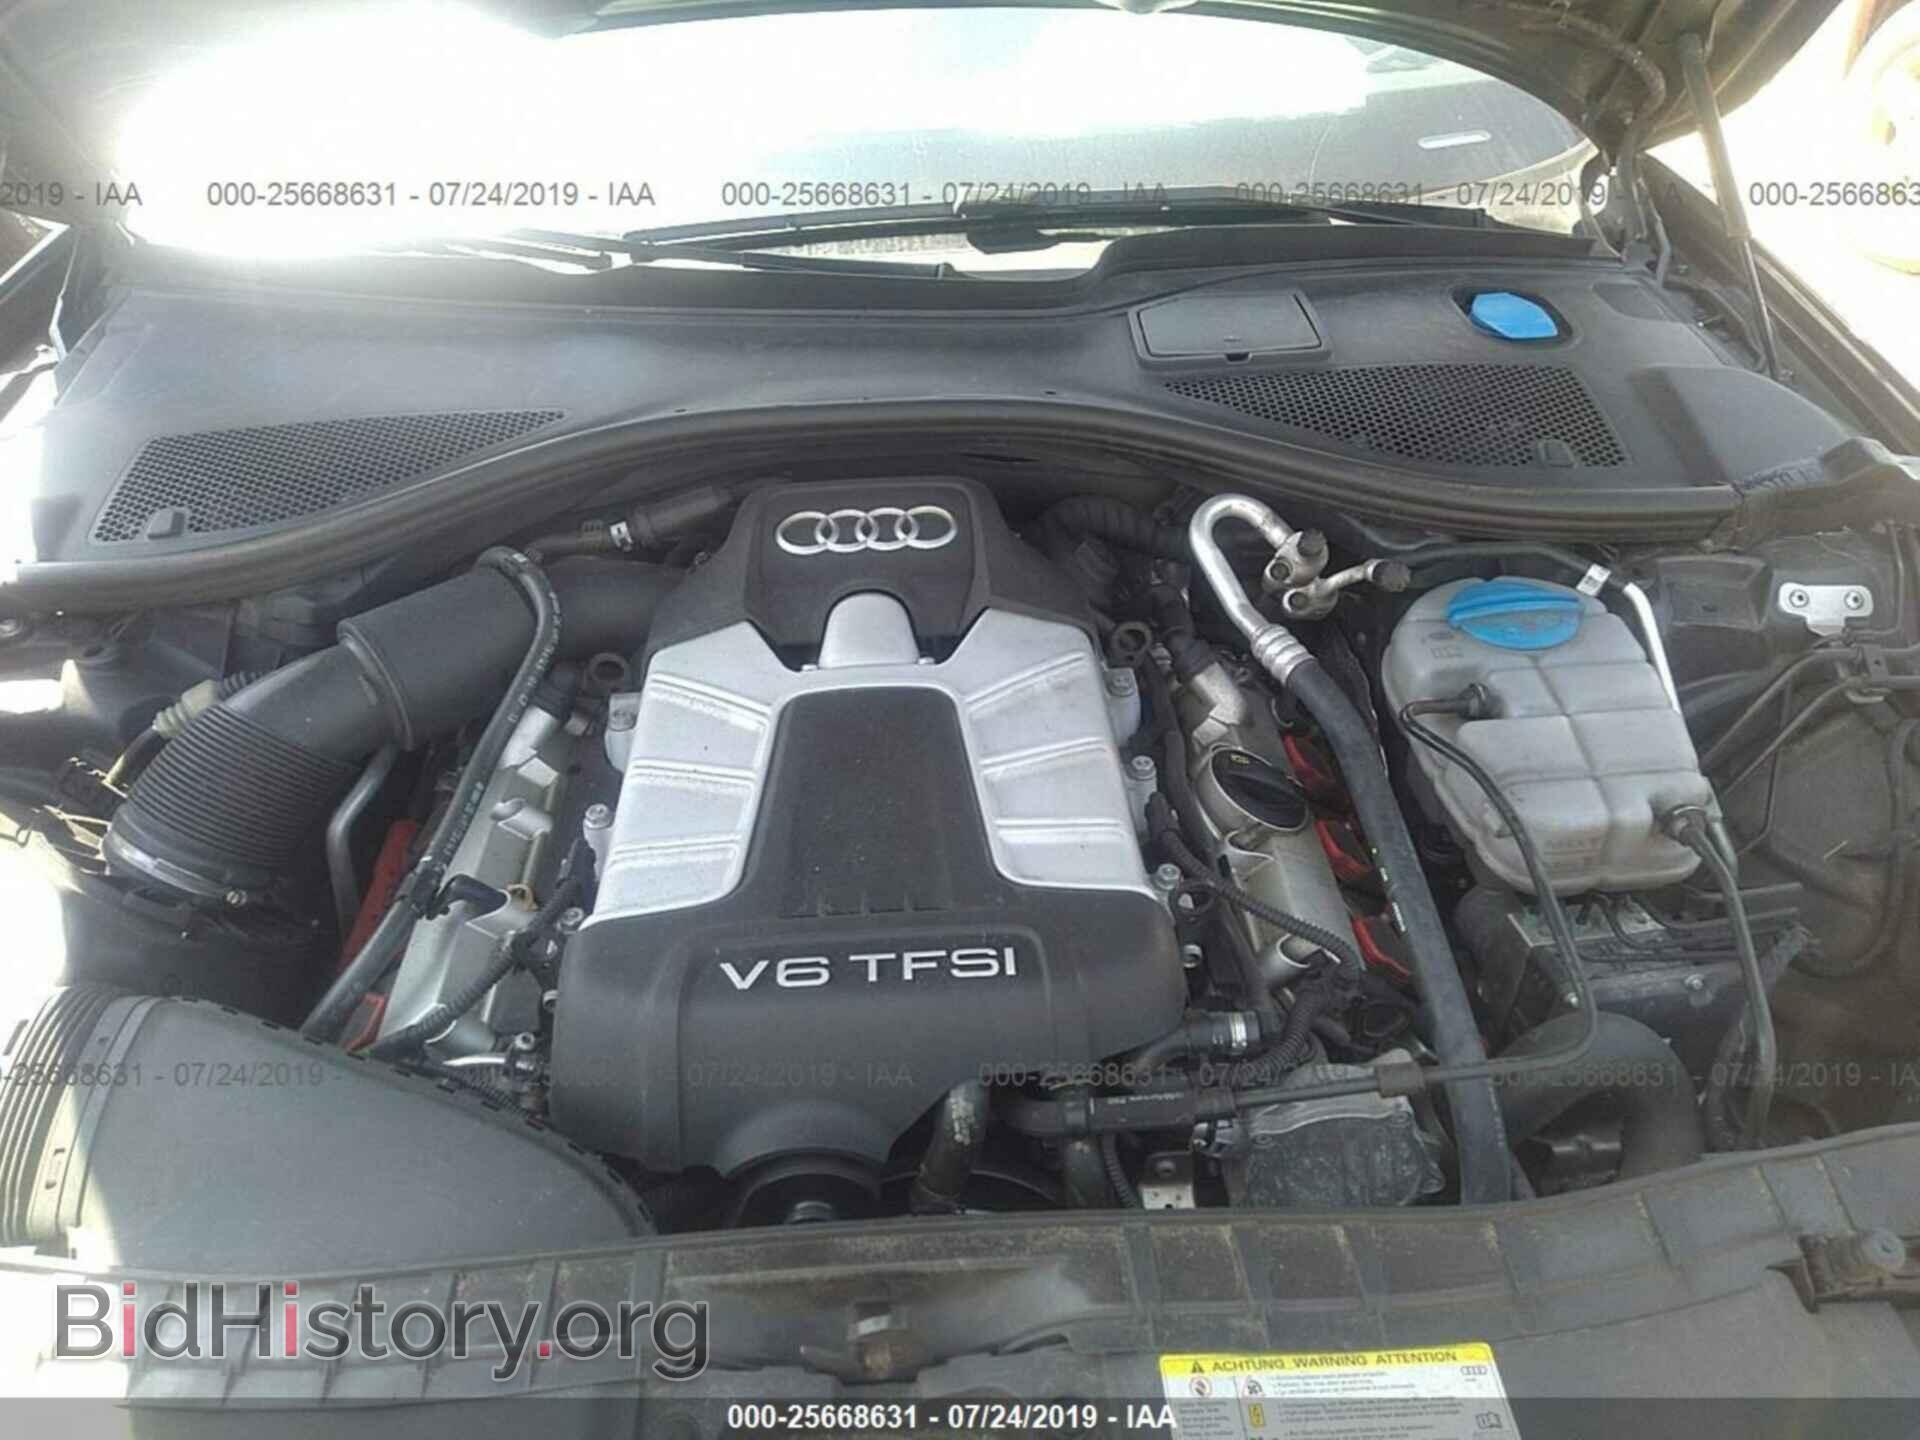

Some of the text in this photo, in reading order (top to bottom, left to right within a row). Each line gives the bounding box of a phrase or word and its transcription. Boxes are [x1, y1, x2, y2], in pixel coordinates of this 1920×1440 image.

[719, 946, 1017, 991] V6 TFSI
[1212, 1350, 1457, 1372] ACHTUNG WARNING ATTENTION
